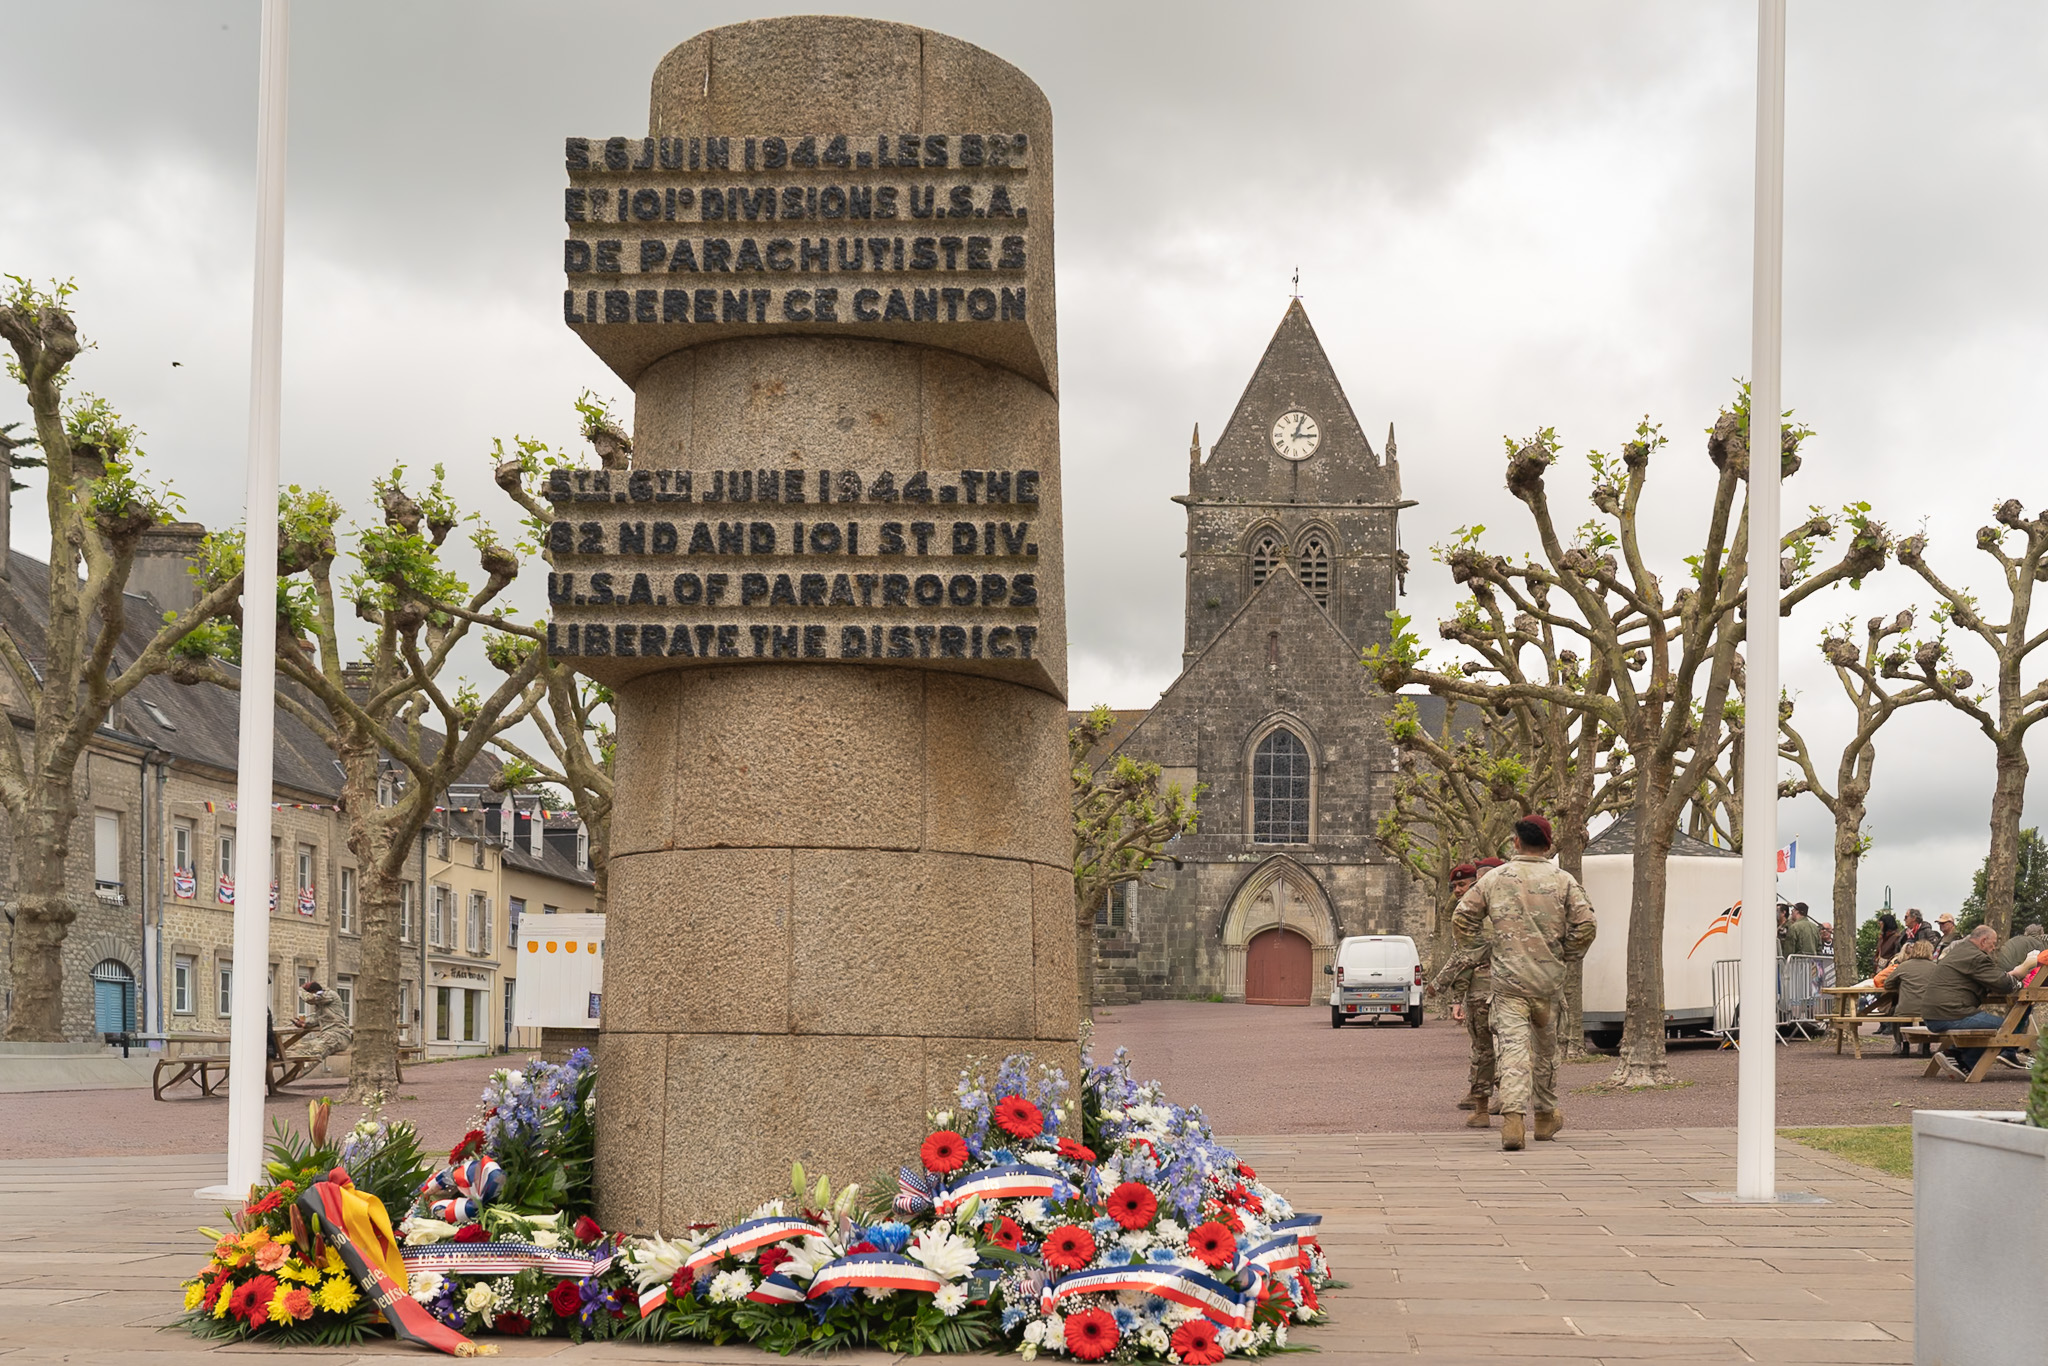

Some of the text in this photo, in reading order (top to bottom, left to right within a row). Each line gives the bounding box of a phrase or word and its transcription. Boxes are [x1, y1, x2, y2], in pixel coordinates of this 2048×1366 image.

[632, 135, 730, 170] JUIN
[564, 186, 609, 222] ET
[700, 185, 899, 221] DIVISIONS
[564, 236, 1027, 273] DE PARACHUTISTES
[564, 286, 1027, 324] LIBERENT CE CANTON
[704, 469, 806, 504] JUNE
[687, 520, 777, 555] AND
[951, 521, 1040, 556] DIV.
[672, 572, 731, 607] OF
[740, 572, 1039, 608] PARATROOPS
[547, 623, 1039, 659] LIBERATE THE DISTRICT
